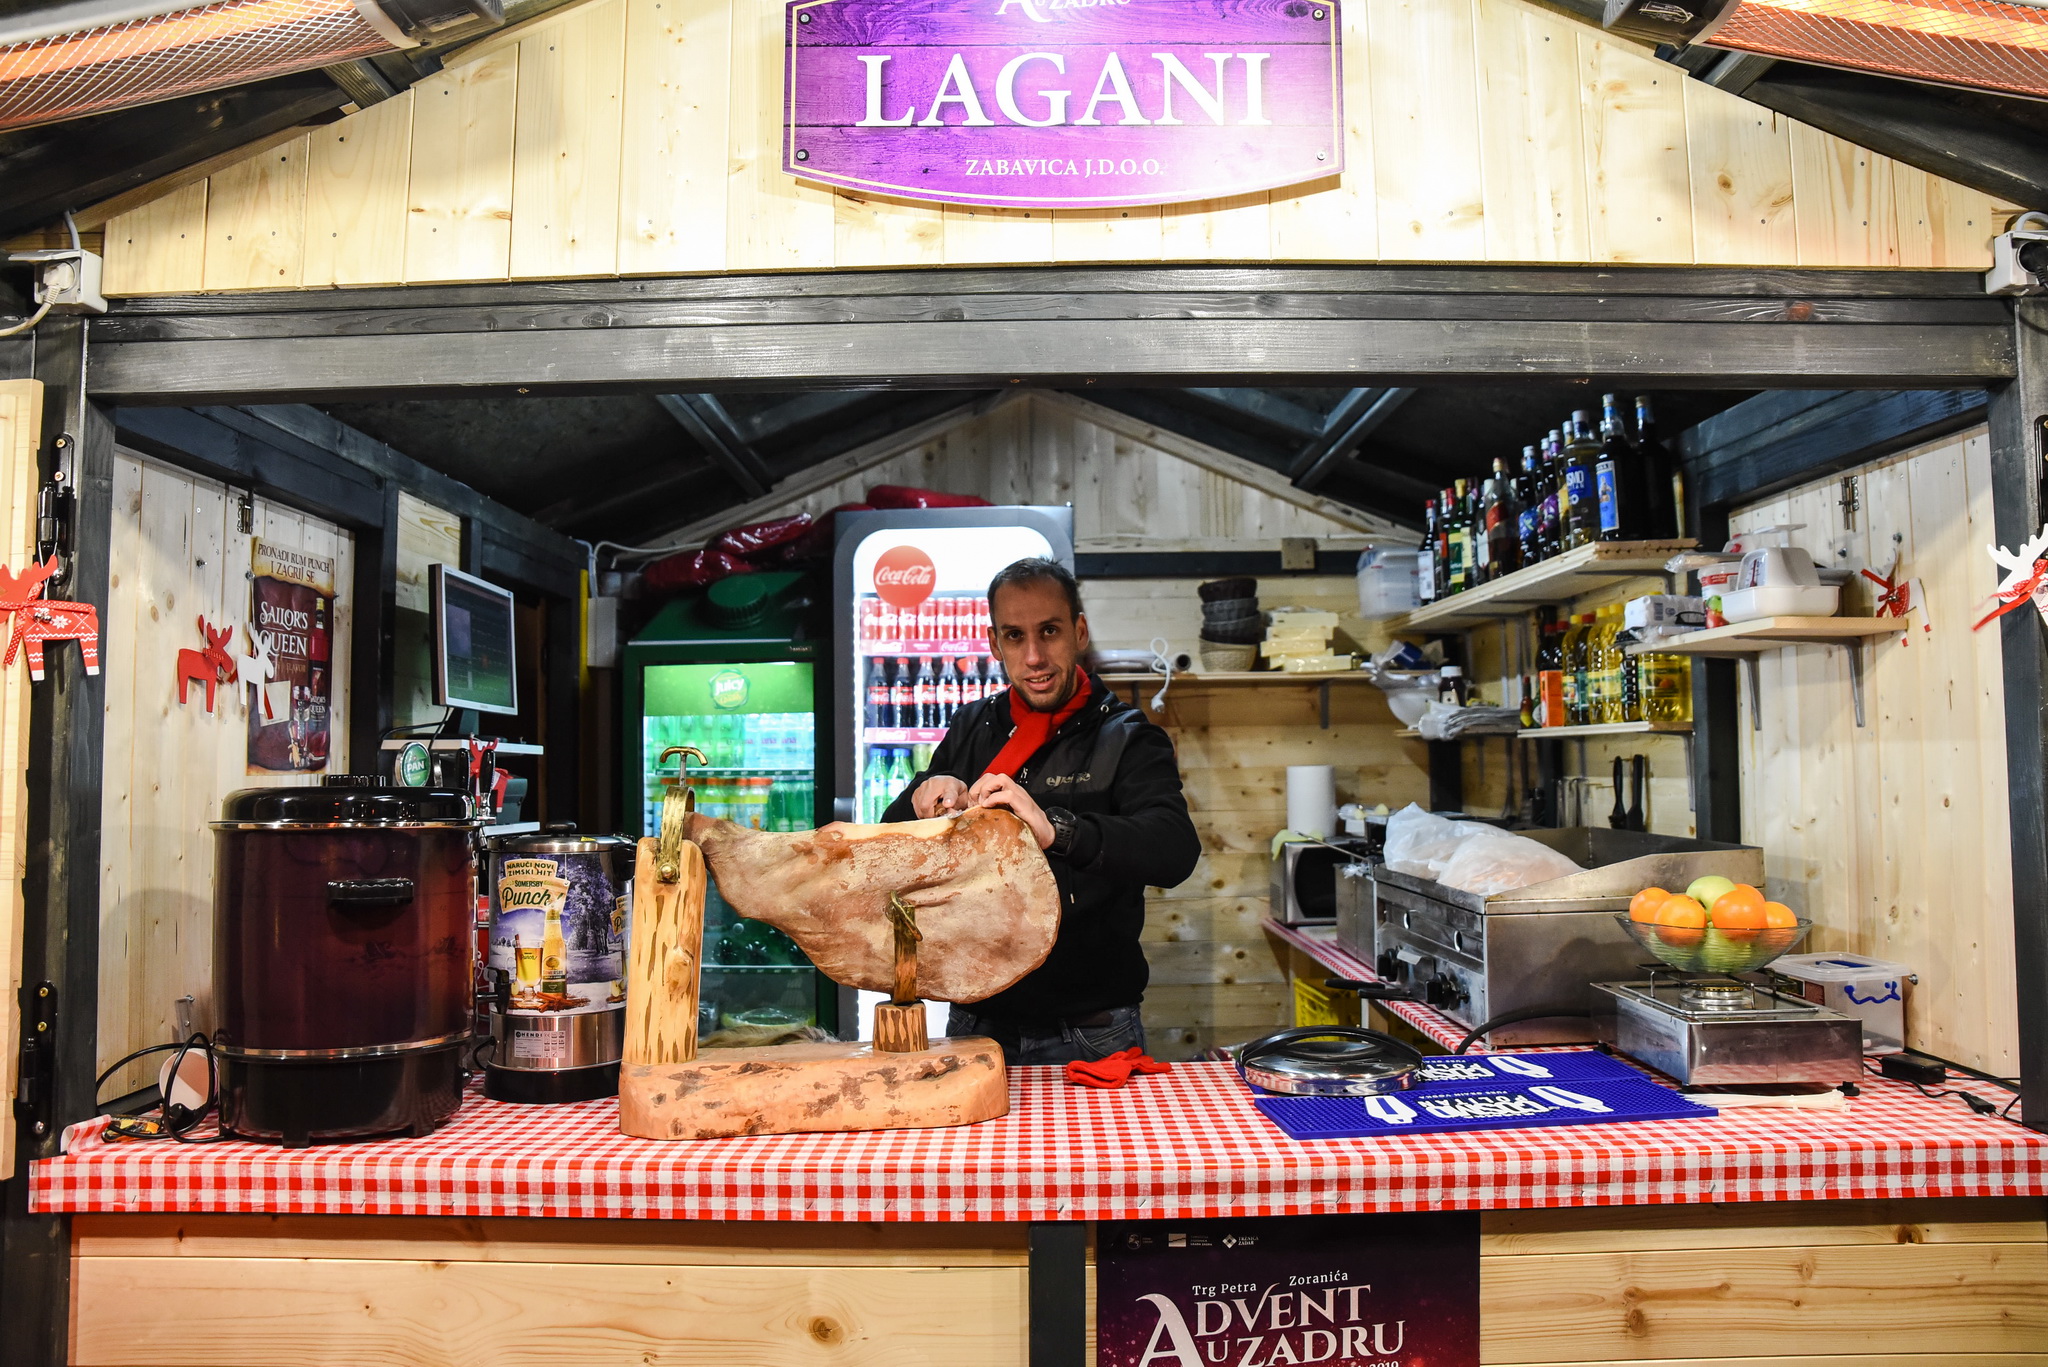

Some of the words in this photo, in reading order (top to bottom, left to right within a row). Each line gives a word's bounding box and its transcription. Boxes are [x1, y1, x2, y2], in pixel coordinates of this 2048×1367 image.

[855, 51, 1273, 127] LAGANI
[965, 158, 1079, 176] ZABAVICA
[1084, 159, 1165, 179] J.D.O.O.
[291, 553, 307, 567] RUM
[307, 558, 330, 573] PUNCH
[270, 561, 274, 573] I
[276, 562, 304, 581] ZAGRIJ
[306, 569, 315, 583] SE
[406, 760, 425, 772] PAN
[506, 861, 532, 870] NARUČI
[534, 862, 554, 870] NOVI
[508, 869, 534, 877] ZIMSKI
[514, 880, 544, 888] SOMERSBY
[1414, 1066, 1496, 1078] COSM
[1426, 1062, 1483, 1071] POLI
[1417, 1094, 1529, 1108] POLITAN
[1425, 1100, 1550, 1118] COSMO
[1192, 1284, 1217, 1298] Trg
[1220, 1281, 1257, 1295] Petra
[1289, 1269, 1349, 1287] Zoranića
[1135, 1283, 1371, 1367] ADVENT
